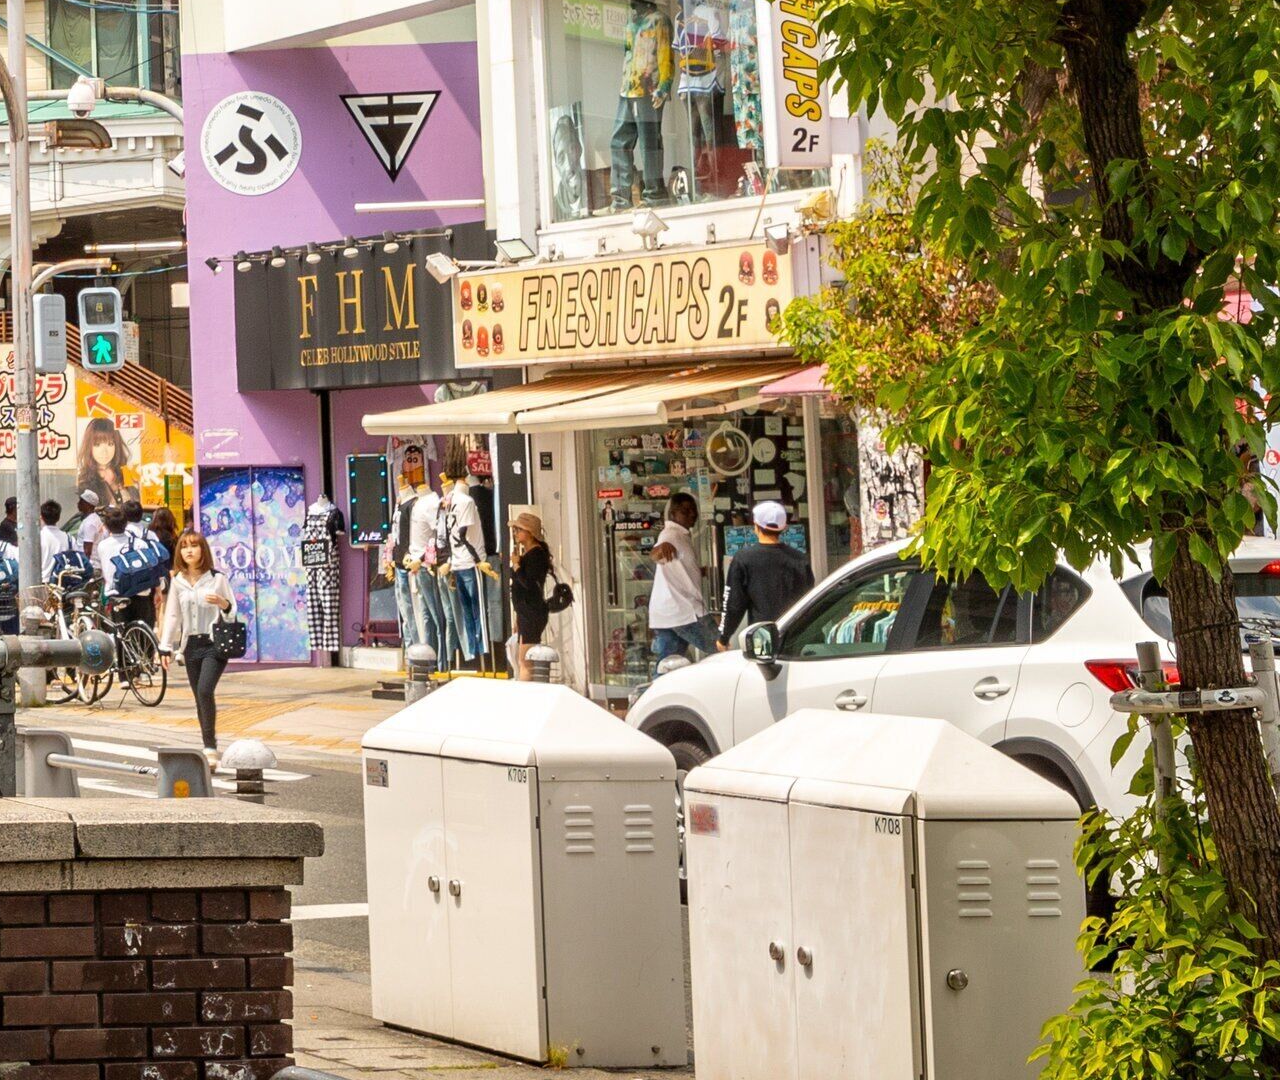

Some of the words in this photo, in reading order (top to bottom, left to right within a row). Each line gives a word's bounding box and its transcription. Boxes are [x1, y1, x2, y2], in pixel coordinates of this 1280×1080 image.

[781, 19, 822, 123] CAPS
[791, 127, 820, 153] 2F
[518, 264, 622, 352] FRESH
[623, 256, 711, 345] CAPS
[717, 285, 749, 339] 2F
[300, 346, 330, 367] CELEB
[330, 342, 388, 364] HOLLYWOOD
[388, 340, 421, 359] STYLE
[119, 414, 139, 428] 2F
[507, 767, 527, 784] K709
